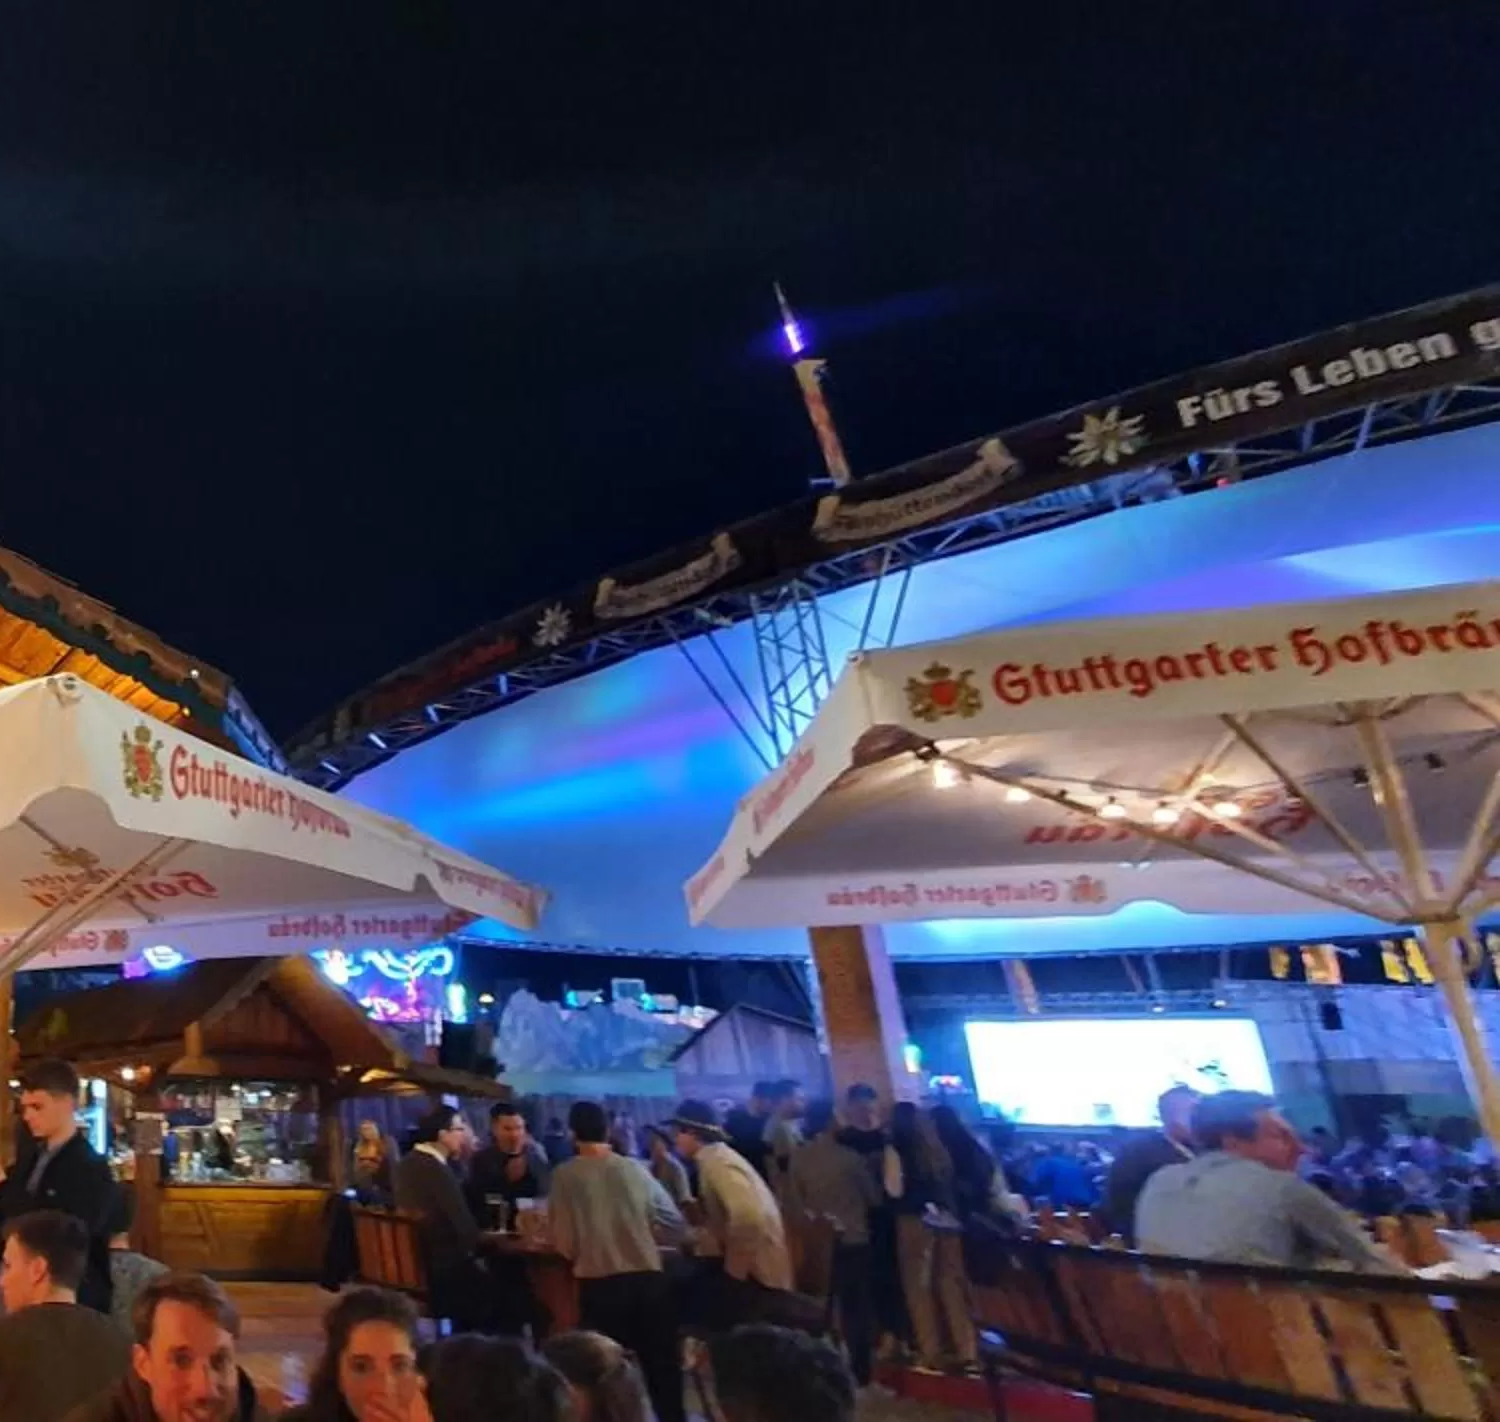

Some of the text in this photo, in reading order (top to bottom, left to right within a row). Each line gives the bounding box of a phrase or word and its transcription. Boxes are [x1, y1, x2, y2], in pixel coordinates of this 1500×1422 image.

[1176, 378, 1284, 428] Fürs
[1290, 331, 1459, 396] Leben
[991, 641, 1280, 705] Stuttgarter
[169, 744, 285, 819] Stuttgarter
